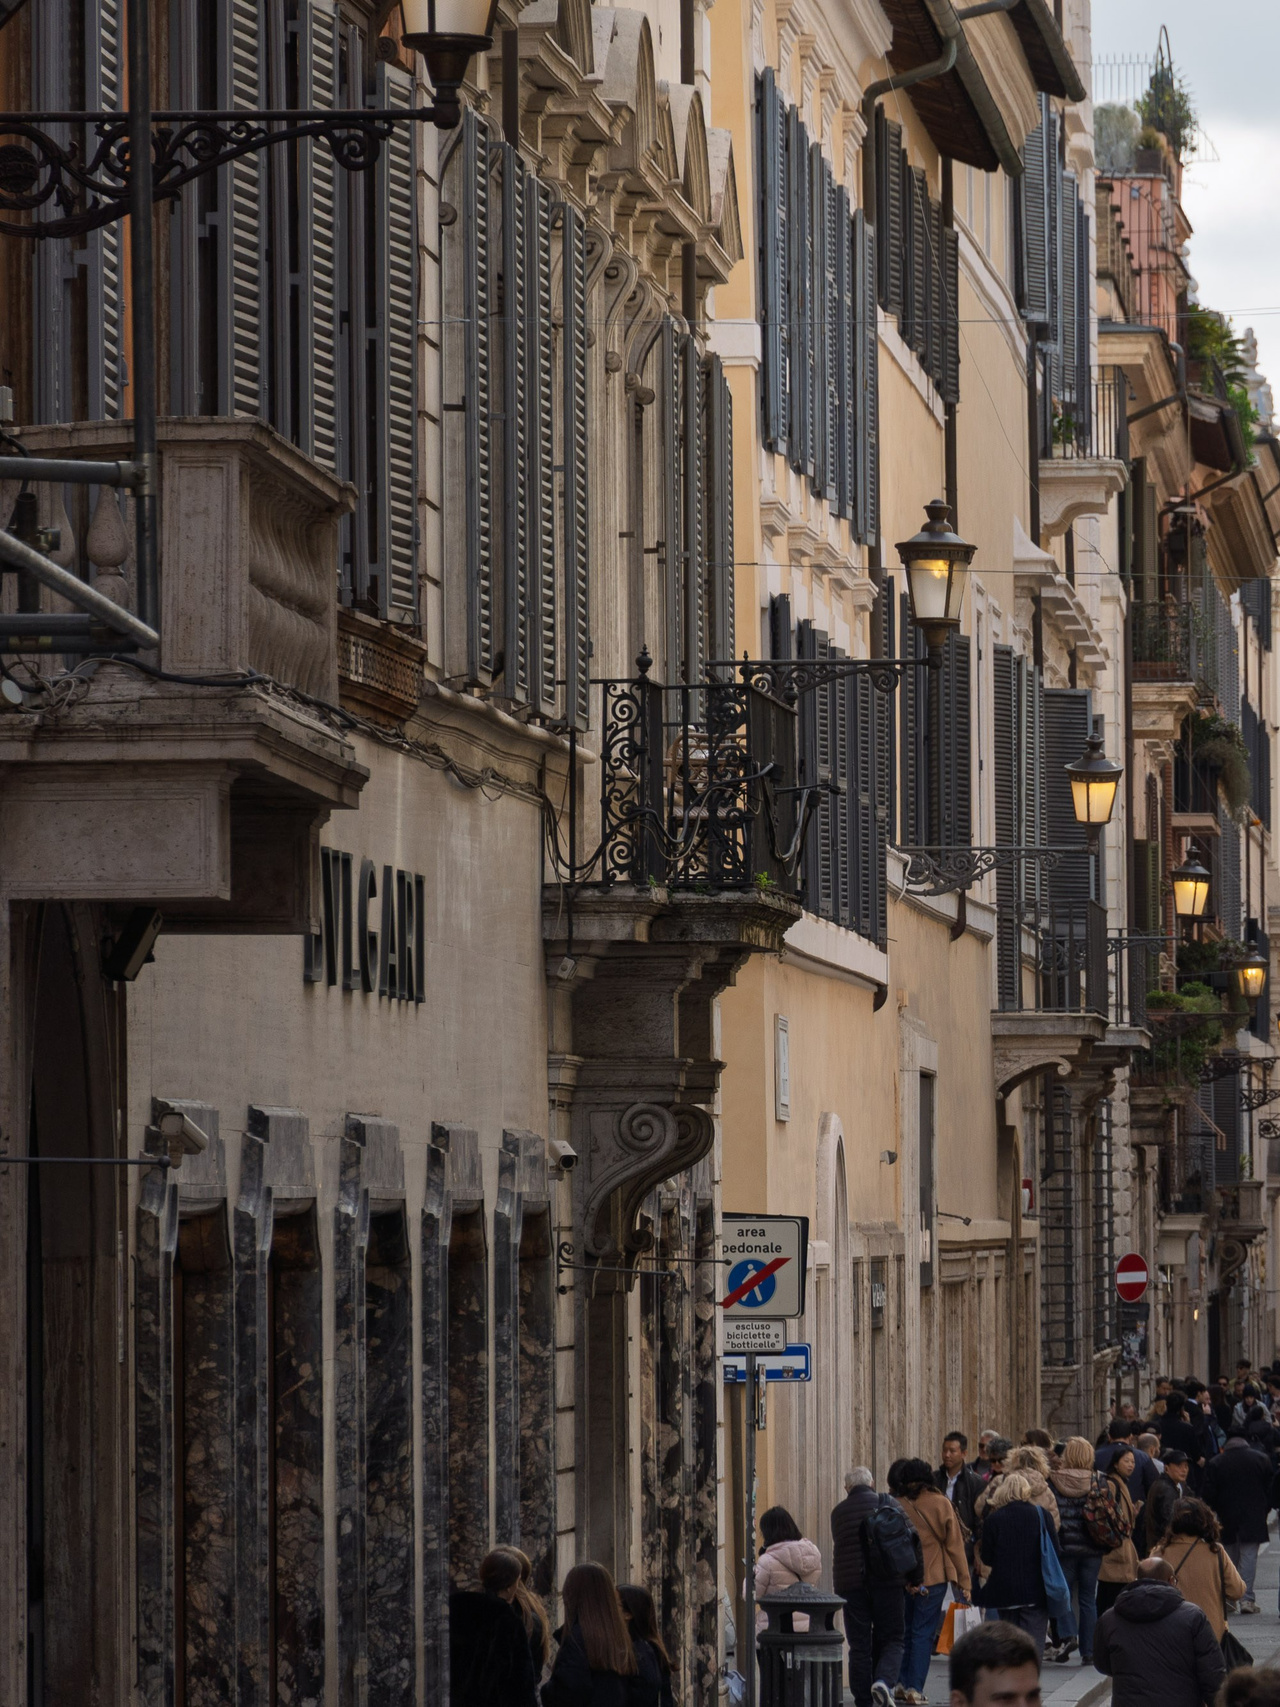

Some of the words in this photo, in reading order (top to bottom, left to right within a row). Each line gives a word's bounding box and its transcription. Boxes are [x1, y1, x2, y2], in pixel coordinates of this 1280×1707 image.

[737, 1228, 766, 1237] area
[722, 1242, 782, 1255] pedonale
[726, 1332, 771, 1340] biciclette
